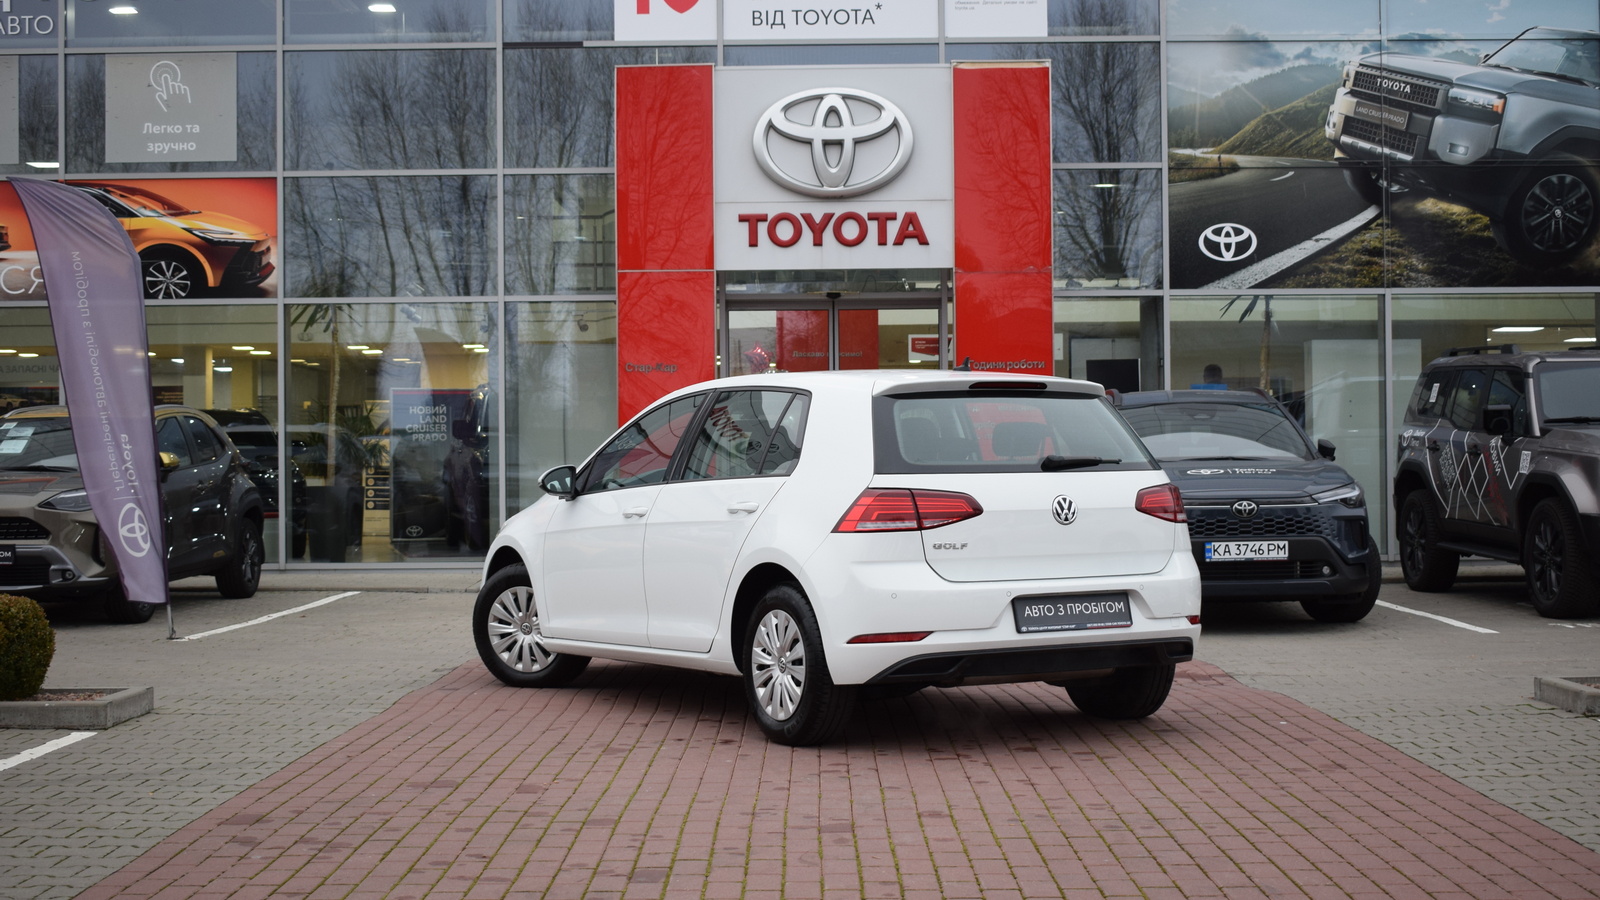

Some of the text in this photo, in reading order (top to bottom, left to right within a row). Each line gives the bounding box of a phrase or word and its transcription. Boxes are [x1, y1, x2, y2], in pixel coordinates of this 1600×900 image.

[751, 10, 786, 29] ВІД
[1376, 78, 1411, 93] TOYOTA
[1356, 106, 1369, 114] LAND
[1388, 113, 1405, 124] PRADO
[142, 122, 200, 134] Легко та
[147, 142, 197, 154] зручно
[738, 211, 930, 248] TOYOTA
[625, 362, 678, 374] Стар-Кар
[1007, 359, 1045, 371] роботи
[409, 403, 447, 414] НОВИЙ
[420, 415, 447, 423] LAND
[405, 424, 447, 432] CRUISER
[412, 433, 447, 441] PRADO
[932, 542, 969, 550] GOLF
[1212, 543, 1232, 556] KA
[1234, 543, 1265, 556] 3746
[1267, 542, 1287, 555] PM
[1024, 604, 1055, 617] АВТО
[1066, 601, 1125, 614] ПРОБІГОМ
